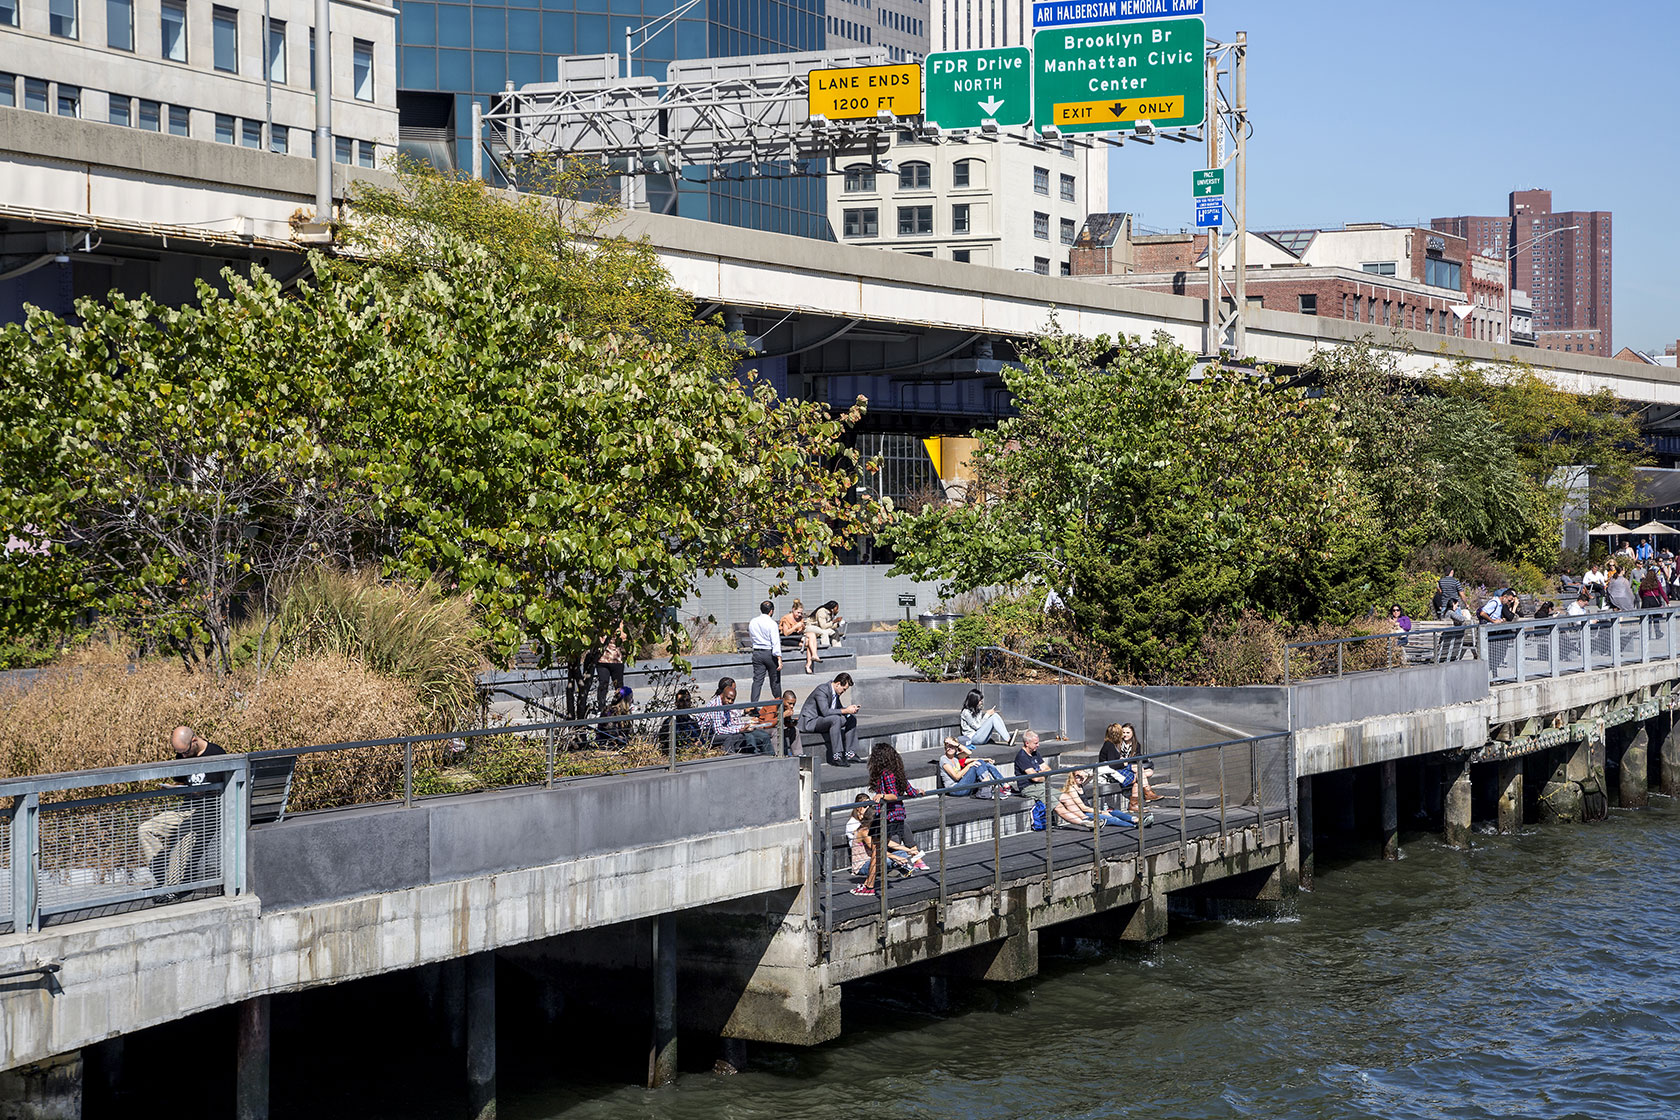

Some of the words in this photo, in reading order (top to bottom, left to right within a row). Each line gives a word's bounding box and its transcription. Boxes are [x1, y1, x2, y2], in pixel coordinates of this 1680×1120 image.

[1037, 7, 1053, 22] ARI
[1057, 2, 1117, 21] HALBERSTAM
[1121, 0, 1168, 15] MEMORIAL
[1172, 0, 1199, 11] RAMP
[1064, 32, 1143, 50] Brooklyn
[1152, 28, 1172, 43] Br
[933, 58, 968, 75] FDR
[977, 56, 1023, 72] Drive
[1044, 54, 1137, 73] Manhattan
[1148, 49, 1193, 66] Civic
[819, 76, 860, 90] LANE
[869, 73, 910, 88] ENDS
[954, 77, 1002, 92] NORTH
[1088, 77, 1148, 92] Center
[833, 97, 869, 110] 1200
[878, 96, 895, 108] FT
[1062, 107, 1093, 119] EXIT
[1138, 102, 1174, 114] ONLY
[1196, 178, 1221, 186] UNIVERSITY
